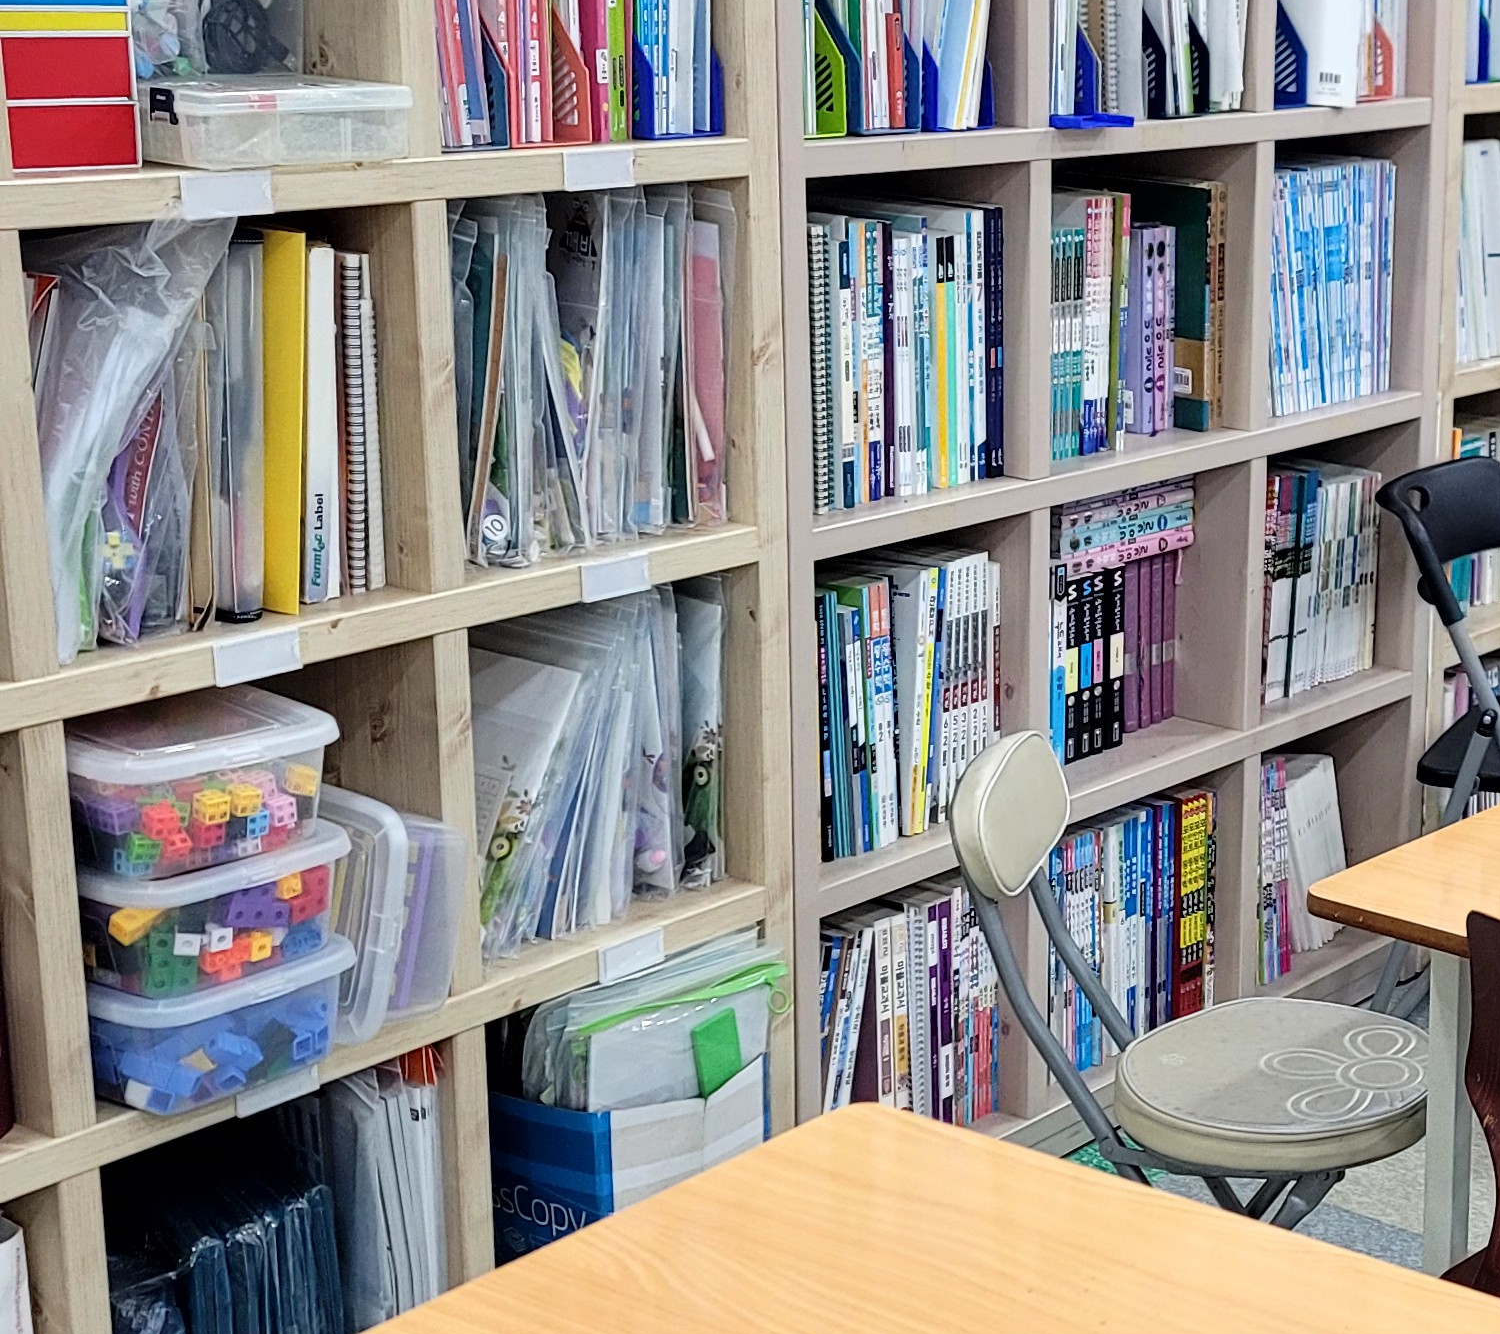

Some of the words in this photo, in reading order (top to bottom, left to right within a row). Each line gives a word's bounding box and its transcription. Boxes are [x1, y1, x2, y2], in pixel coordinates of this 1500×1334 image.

[127, 470, 143, 505] with
[313, 493, 324, 530] Label
[484, 516, 504, 539] 10
